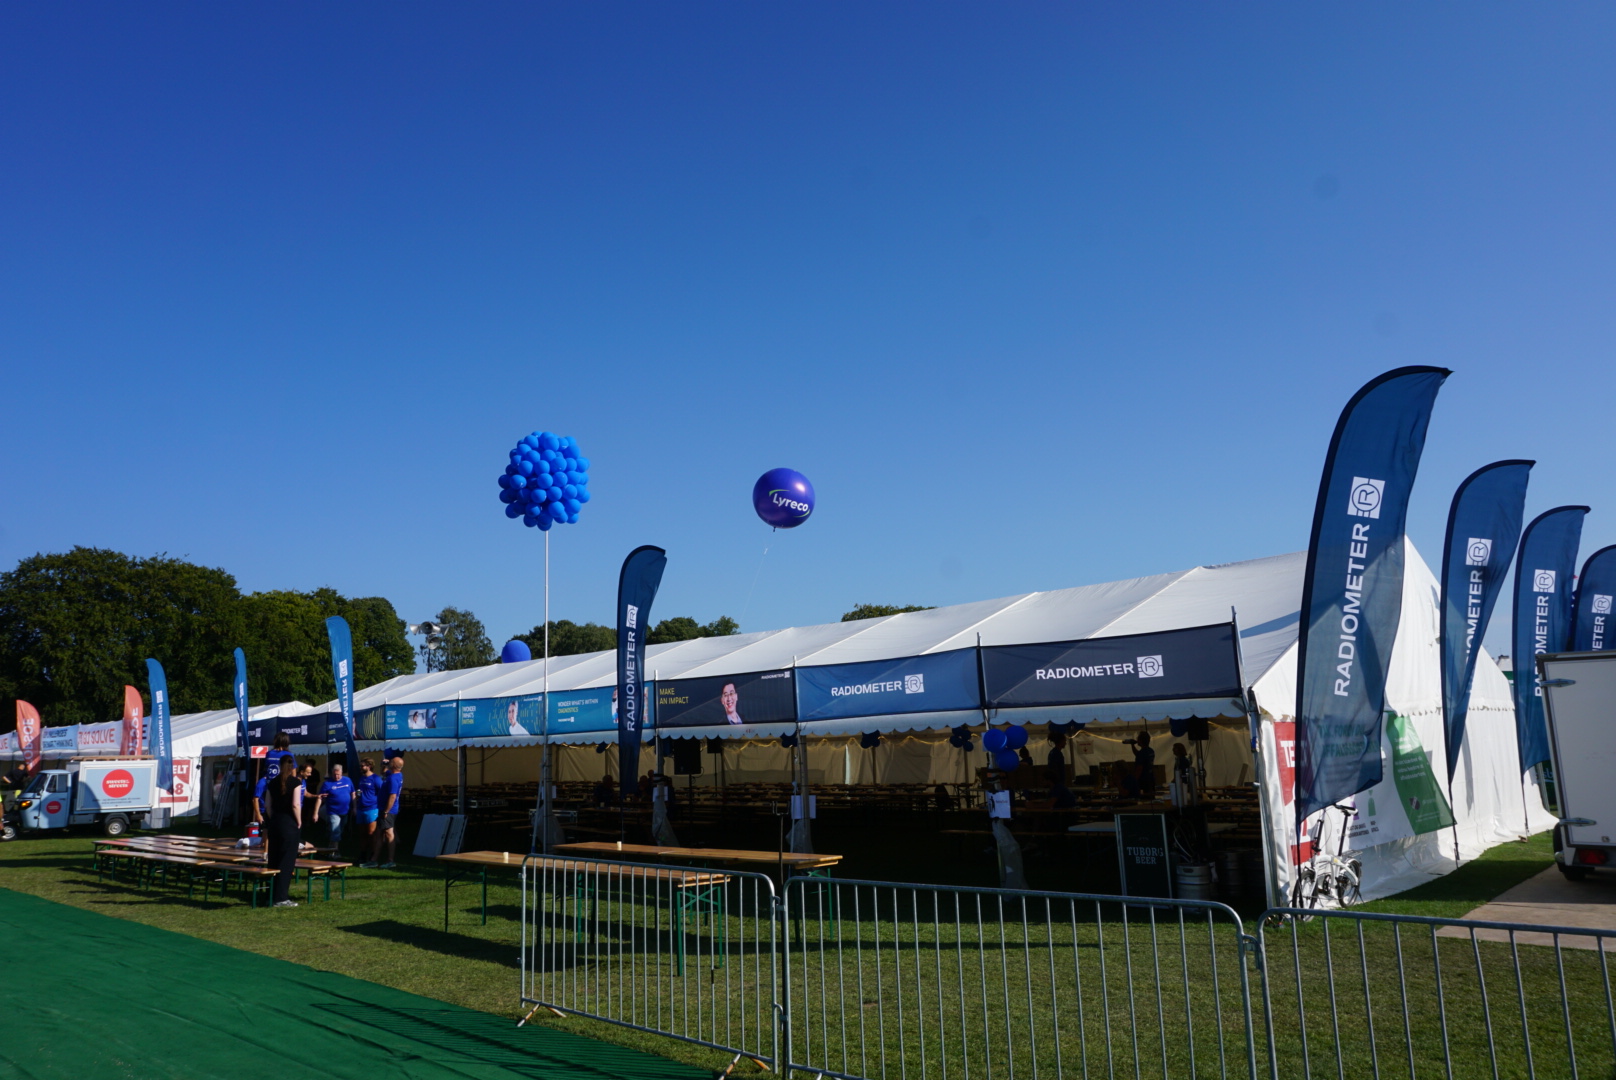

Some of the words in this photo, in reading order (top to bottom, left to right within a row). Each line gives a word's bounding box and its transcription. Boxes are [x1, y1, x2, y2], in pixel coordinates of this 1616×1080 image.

[773, 493, 809, 512] Lyreco
[1334, 523, 1370, 697] RADIOMETER
[1036, 663, 1135, 680] RADIOMETER
[626, 631, 636, 731] RADIOMETER
[831, 681, 903, 697] RADIOMETER
[659, 697, 668, 705] AN
[668, 696, 689, 704] IMPACT
[557, 706, 579, 714] DIAGNOSTICS
[91, 728, 115, 744] SOLVE
[1126, 846, 1164, 857] TUBORG
[1135, 856, 1157, 865] BEER
